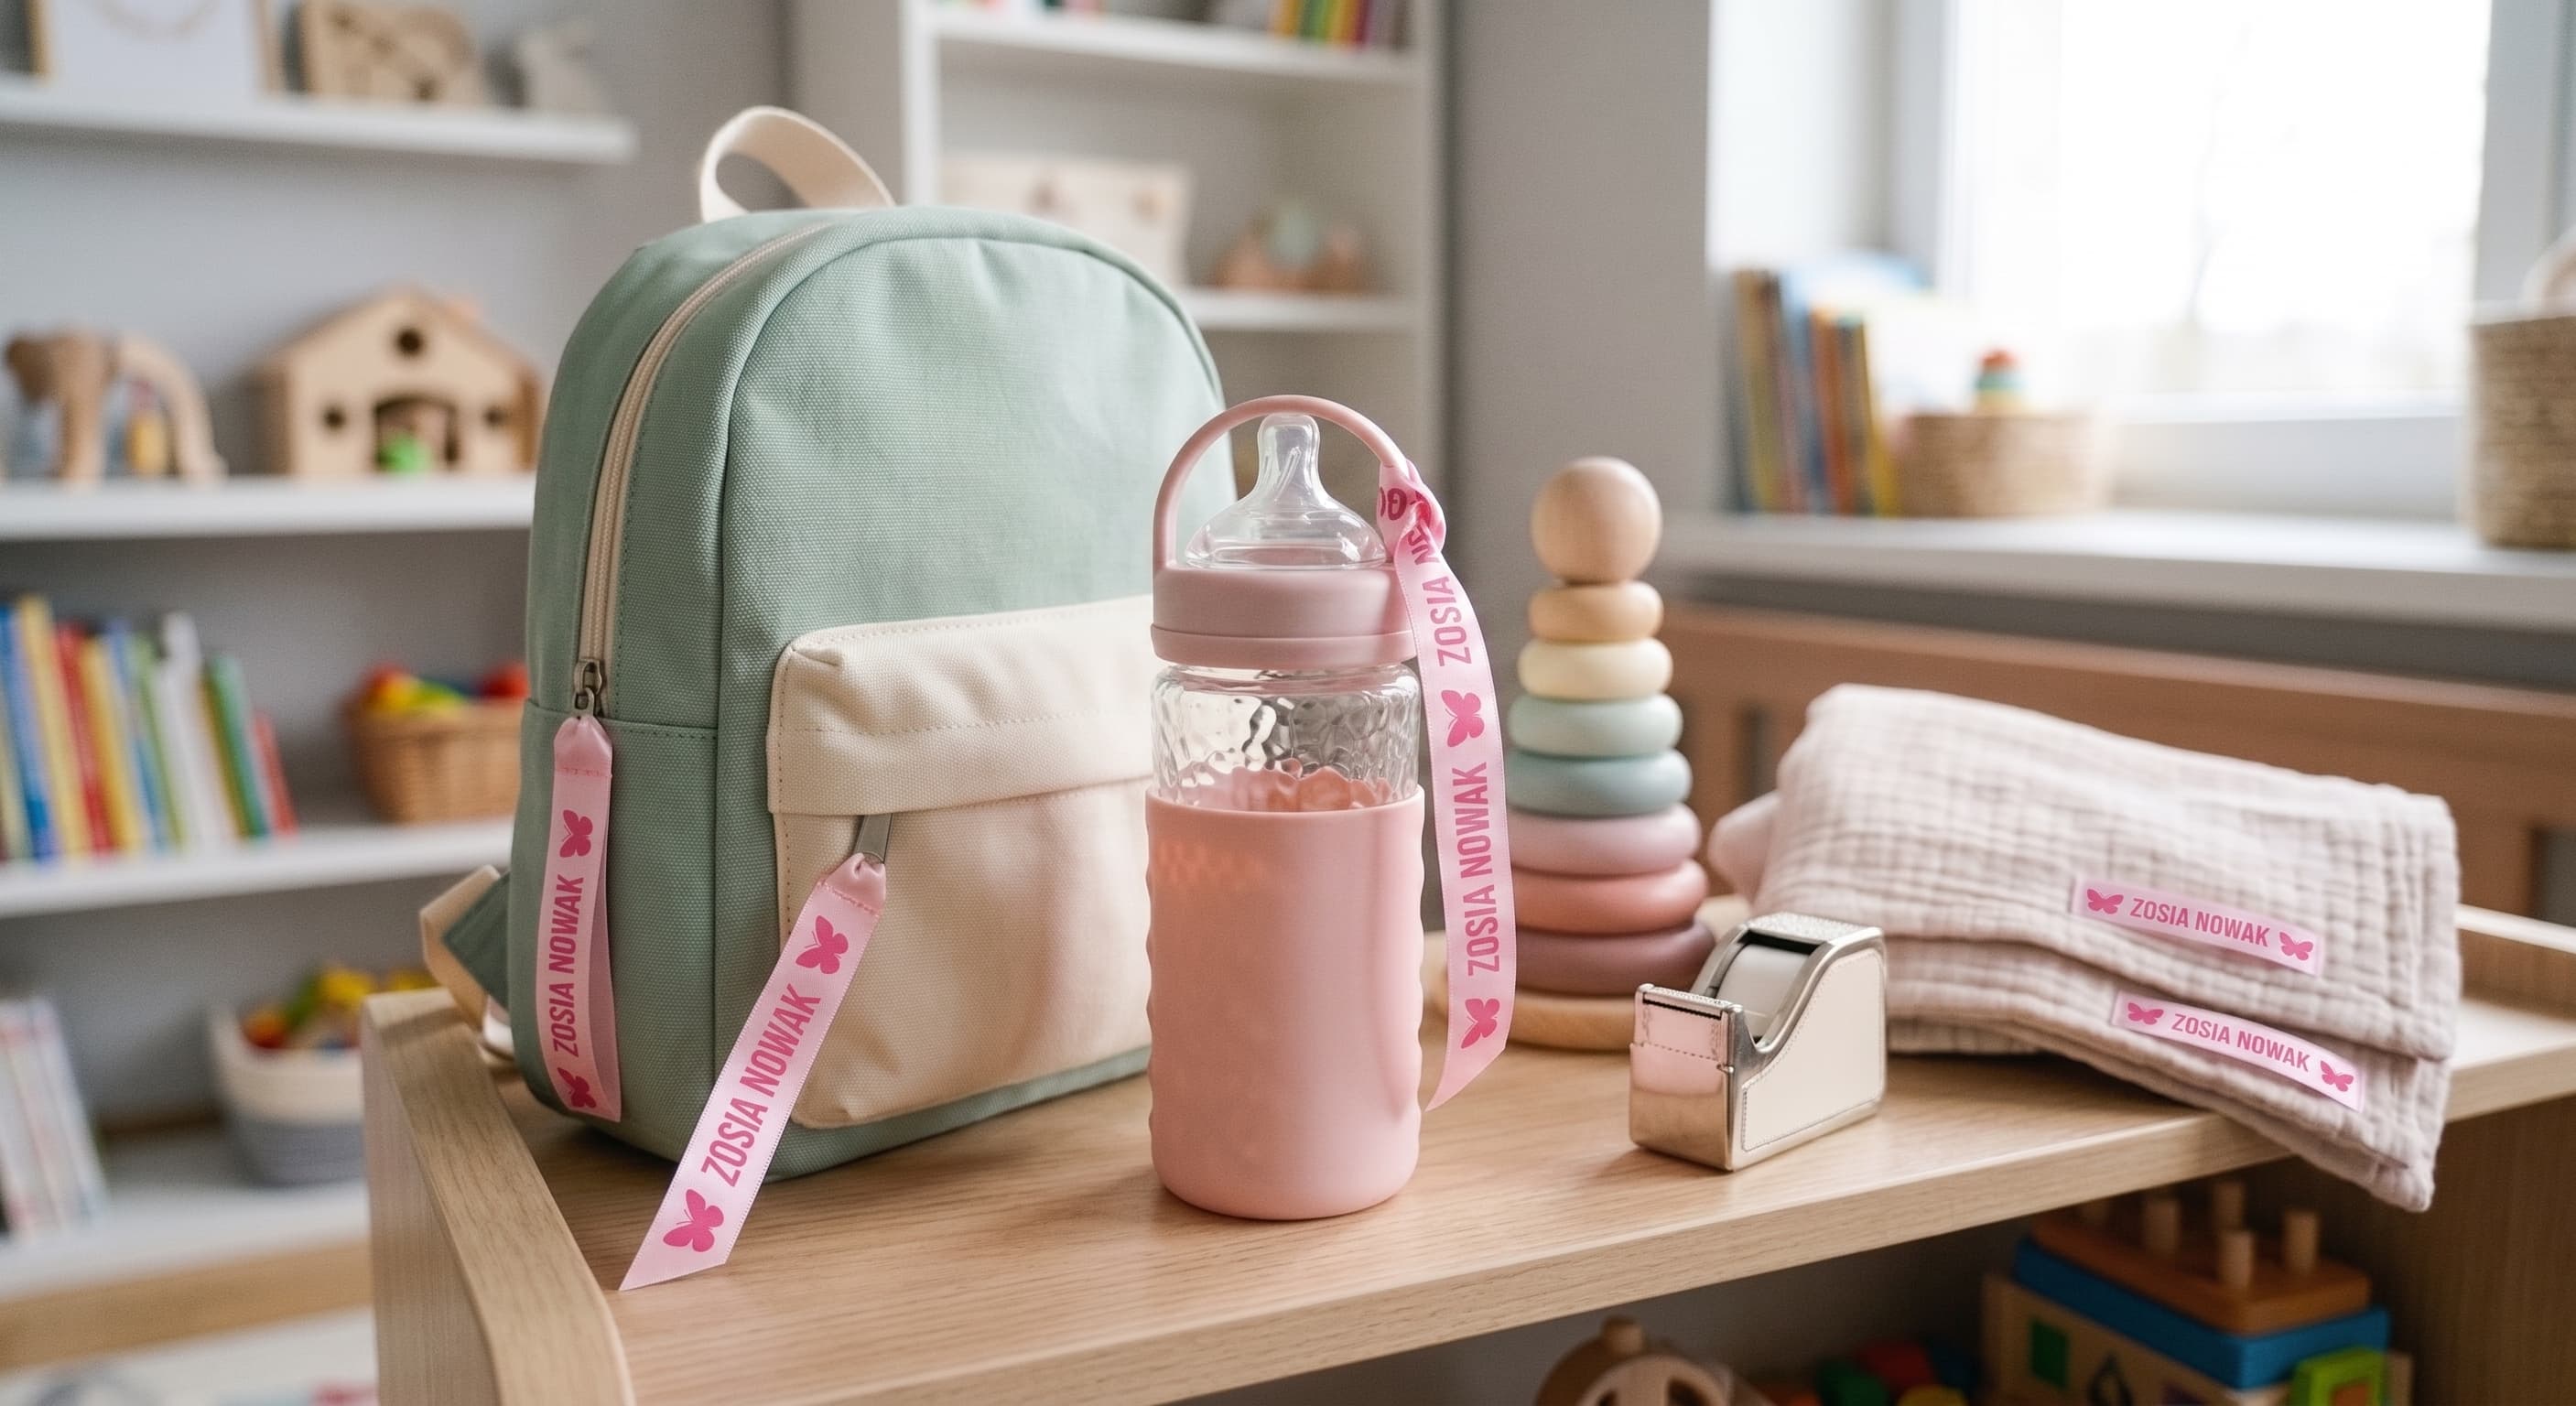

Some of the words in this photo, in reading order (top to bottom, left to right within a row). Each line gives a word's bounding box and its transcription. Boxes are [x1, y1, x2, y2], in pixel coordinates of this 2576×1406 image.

[1422, 576, 1472, 666] ZOSIA
[1452, 762, 1493, 879] NOWAK
[548, 874, 584, 972] NOWAK
[1463, 884, 1499, 977] ZOSIA
[2129, 898, 2189, 927] ZOSIA
[2195, 911, 2270, 946] NOWAK
[548, 982, 579, 1057] ZOSIA
[2171, 1013, 2231, 1045] ZOSIA
[2236, 1031, 2311, 1072] NOWAK
[701, 1098, 767, 1187] ZOSIA
[740, 983, 820, 1098] NOWAK
